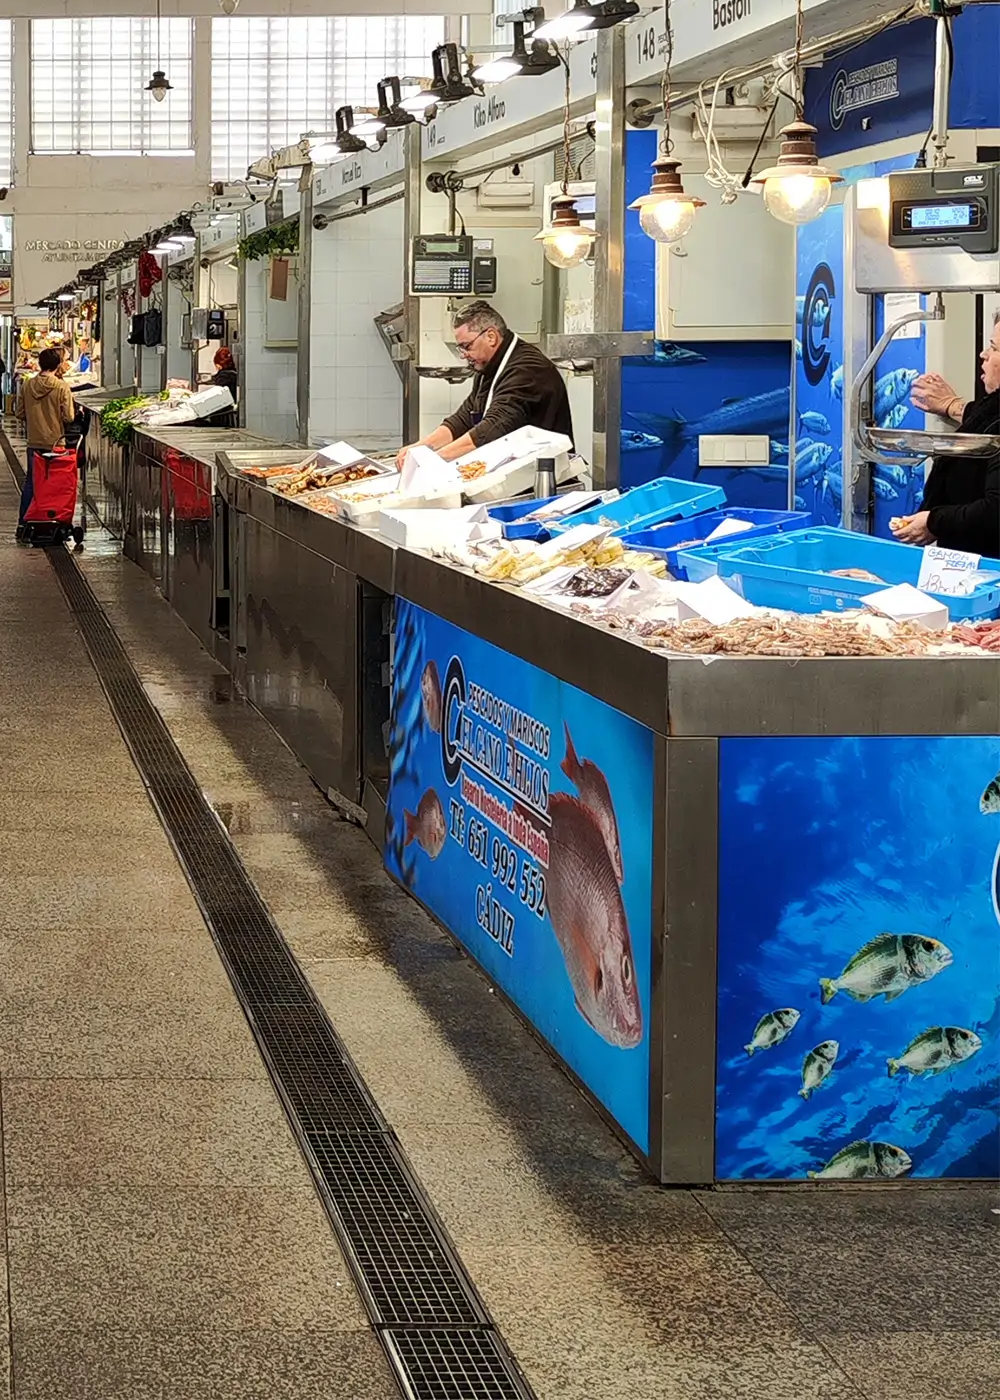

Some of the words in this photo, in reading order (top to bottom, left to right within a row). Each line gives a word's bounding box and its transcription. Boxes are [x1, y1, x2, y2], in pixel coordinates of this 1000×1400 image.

[637, 27, 655, 64] 148
[25, 239, 81, 250] MERCADO
[83, 239, 125, 250] CENTRA
[468, 681, 503, 731] PESCADOS
[509, 706, 551, 760] MARISCOS
[461, 715, 474, 757] EL
[474, 724, 503, 778] CANO
[503, 743, 514, 786] E
[513, 749, 550, 811] HIJOS
[449, 798, 465, 847] Tf:
[467, 816, 489, 869] 651
[491, 836, 517, 895] 992
[519, 860, 548, 920] 552
[475, 882, 516, 958] CÁDIZ
